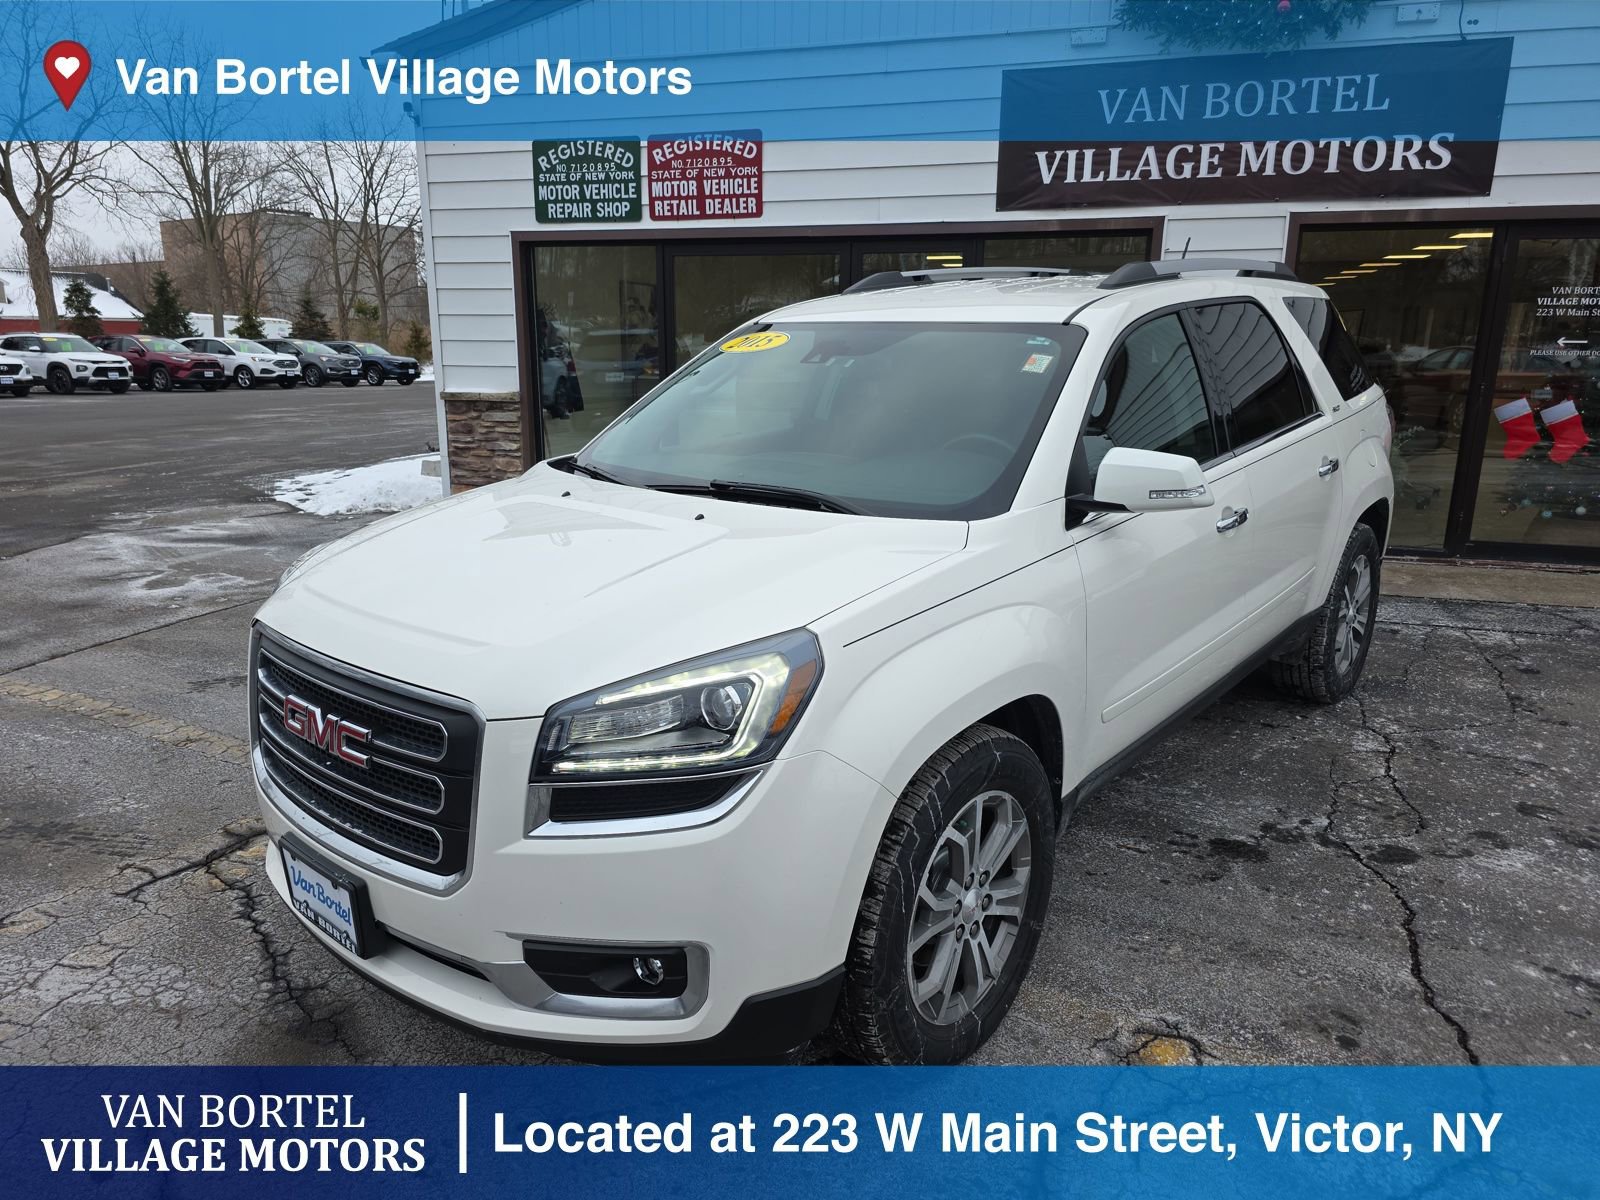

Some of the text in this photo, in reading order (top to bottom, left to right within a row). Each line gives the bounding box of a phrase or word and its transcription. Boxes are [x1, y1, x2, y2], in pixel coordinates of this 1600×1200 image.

[1098, 73, 1390, 125] VAN BORTEL
[537, 140, 634, 172] REGISTERED
[652, 133, 758, 165] REGISTERED
[556, 162, 616, 172] NO. 7120895
[671, 156, 733, 168] NO. 7120895
[1034, 132, 1455, 185] VILLAGE MOTORS
[539, 170, 635, 182] STATE OF NEW YORK
[651, 166, 758, 180] STATE OF NEW YORK
[538, 182, 638, 201] MOTOR VEHICLE
[651, 177, 759, 197] MOTOR VEHICLE
[547, 201, 630, 218] REPAIR SHOP
[654, 197, 757, 216] RETAIL DEALER
[1552, 286, 1572, 294] VAN
[1537, 297, 1579, 305] VILLAGE
[1536, 308, 1553, 316] 223
[1556, 308, 1566, 316] W
[1567, 308, 1590, 316] Main
[283, 694, 372, 769] GMC
